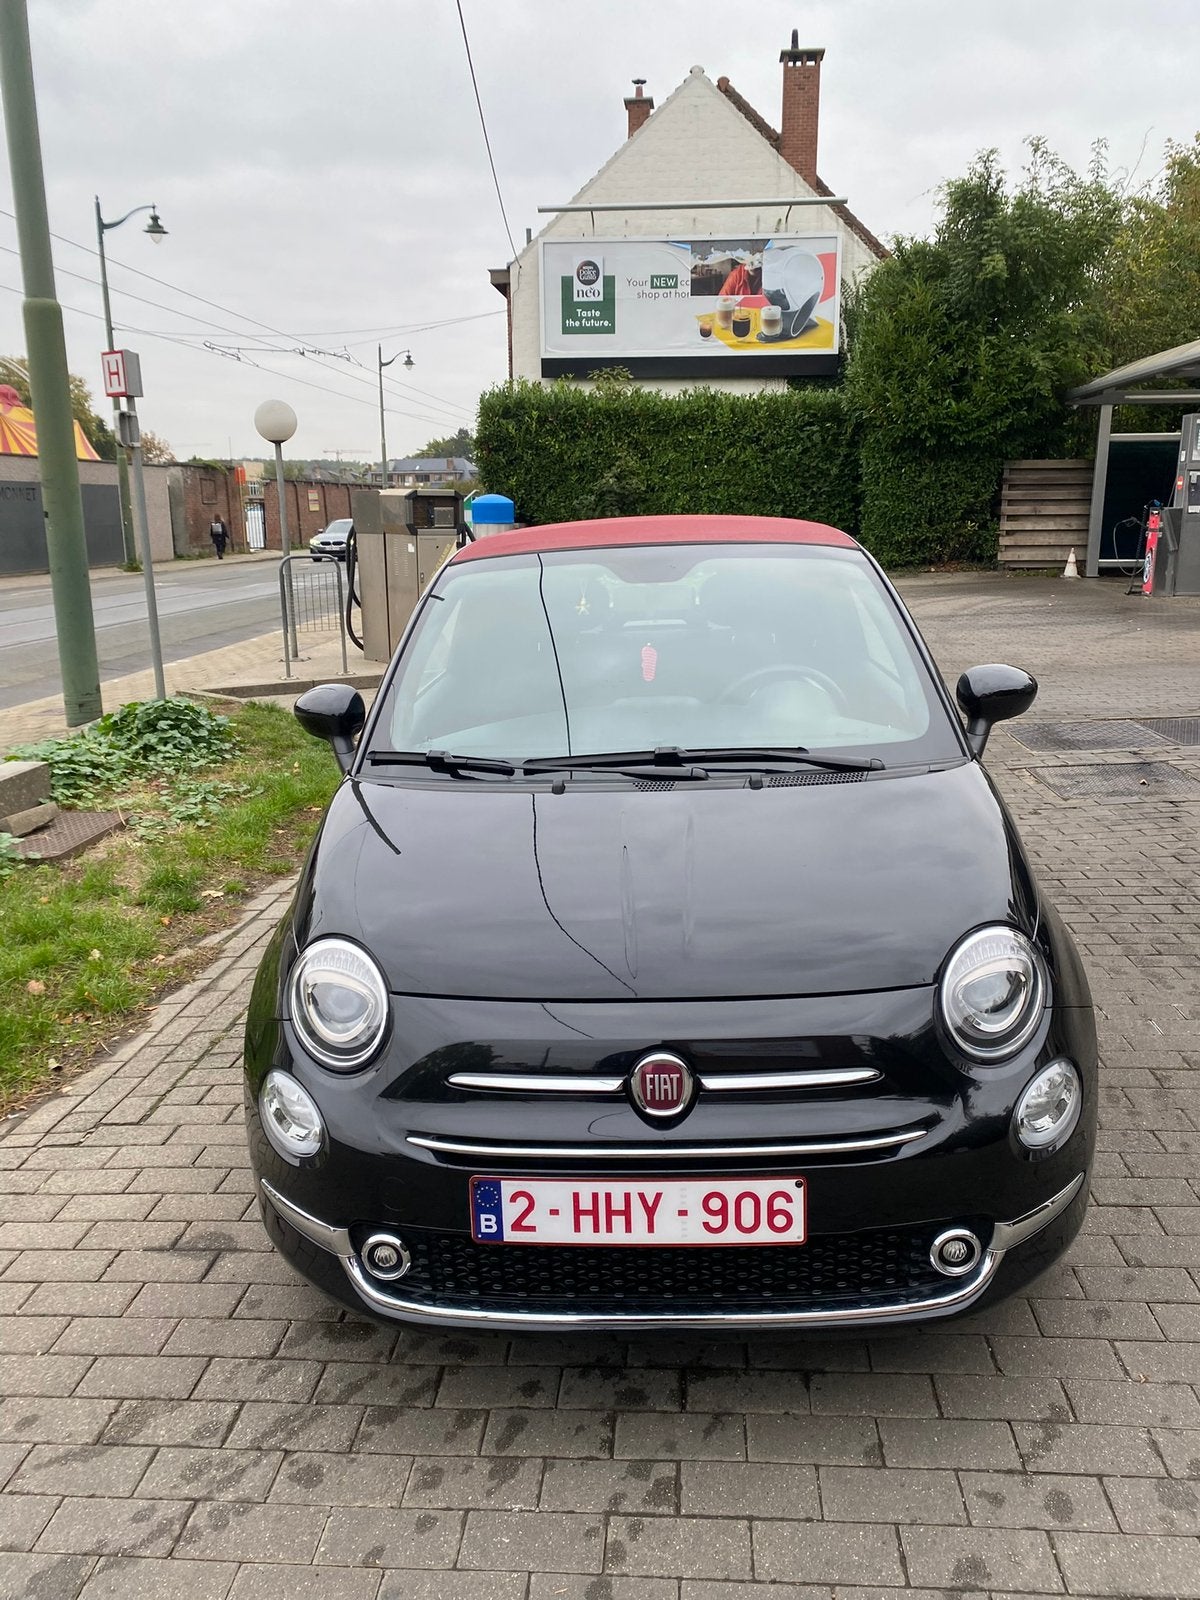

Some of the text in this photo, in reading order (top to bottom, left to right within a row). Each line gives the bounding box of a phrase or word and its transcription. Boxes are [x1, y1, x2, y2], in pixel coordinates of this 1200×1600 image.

[626, 277, 648, 287] Your
[653, 277, 676, 287] NEW
[637, 290, 660, 300] shop
[662, 290, 672, 299] at
[576, 309, 601, 317] Taste
[565, 318, 612, 327] the future.
[106, 358, 121, 388] H
[645, 1073, 681, 1101] FIAT
[479, 1190, 794, 1234] B 2-HHY-906
